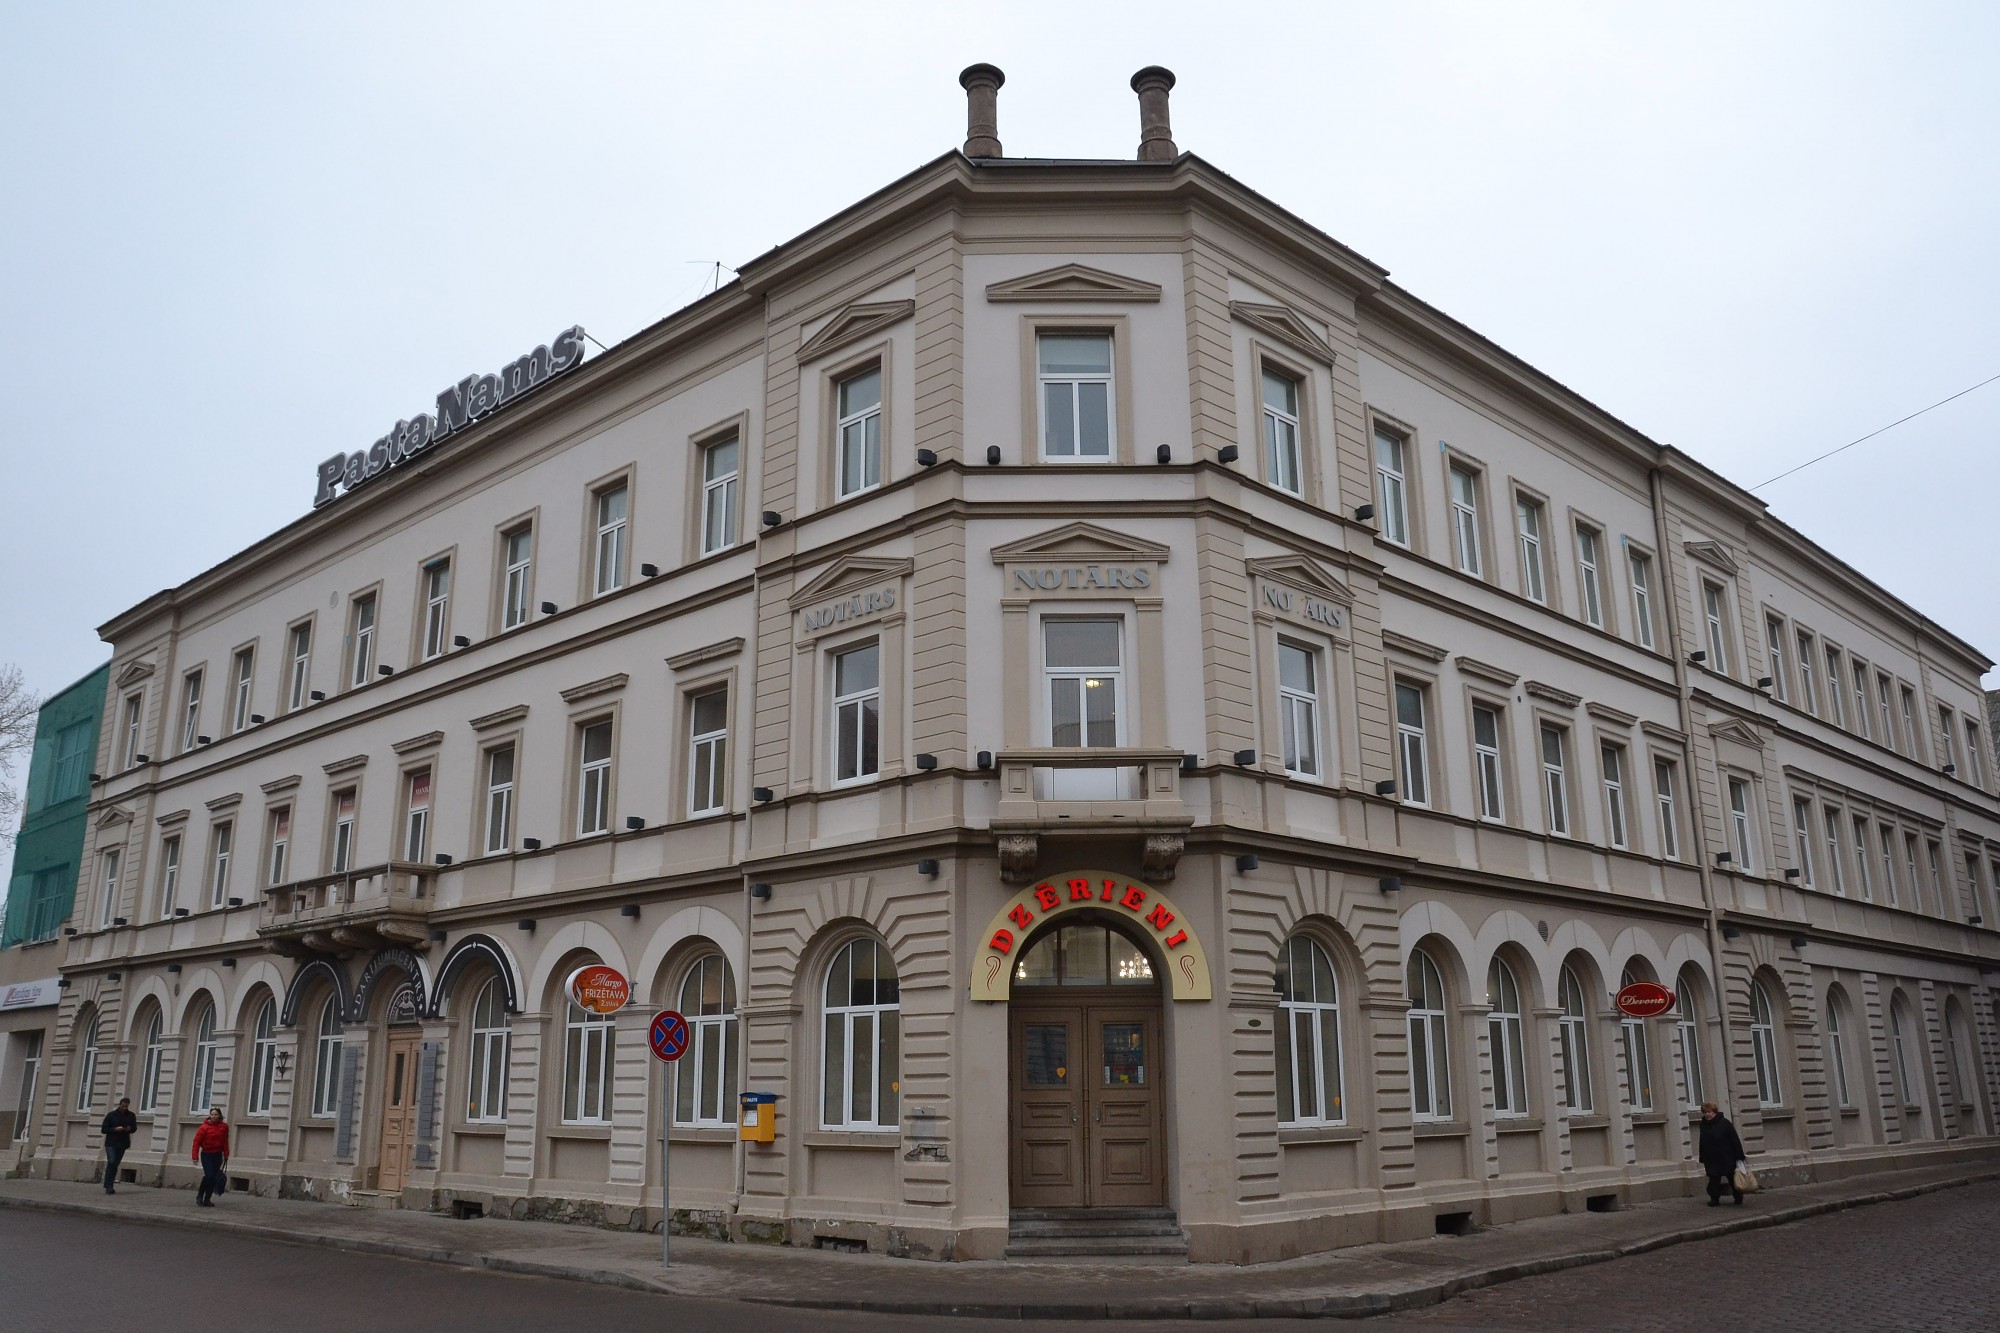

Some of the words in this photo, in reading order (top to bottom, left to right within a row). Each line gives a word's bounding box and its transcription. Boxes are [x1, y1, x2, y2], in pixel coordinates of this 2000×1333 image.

[1014, 565, 1151, 590] NOTĀRS
[803, 586, 895, 632] NOTĀRS
[1263, 585, 1342, 628] NOĀRS
[989, 878, 1189, 955] DZĒRIENI
[585, 988, 625, 999] FRIZĒTAVA
[591, 973, 622, 989] Margo
